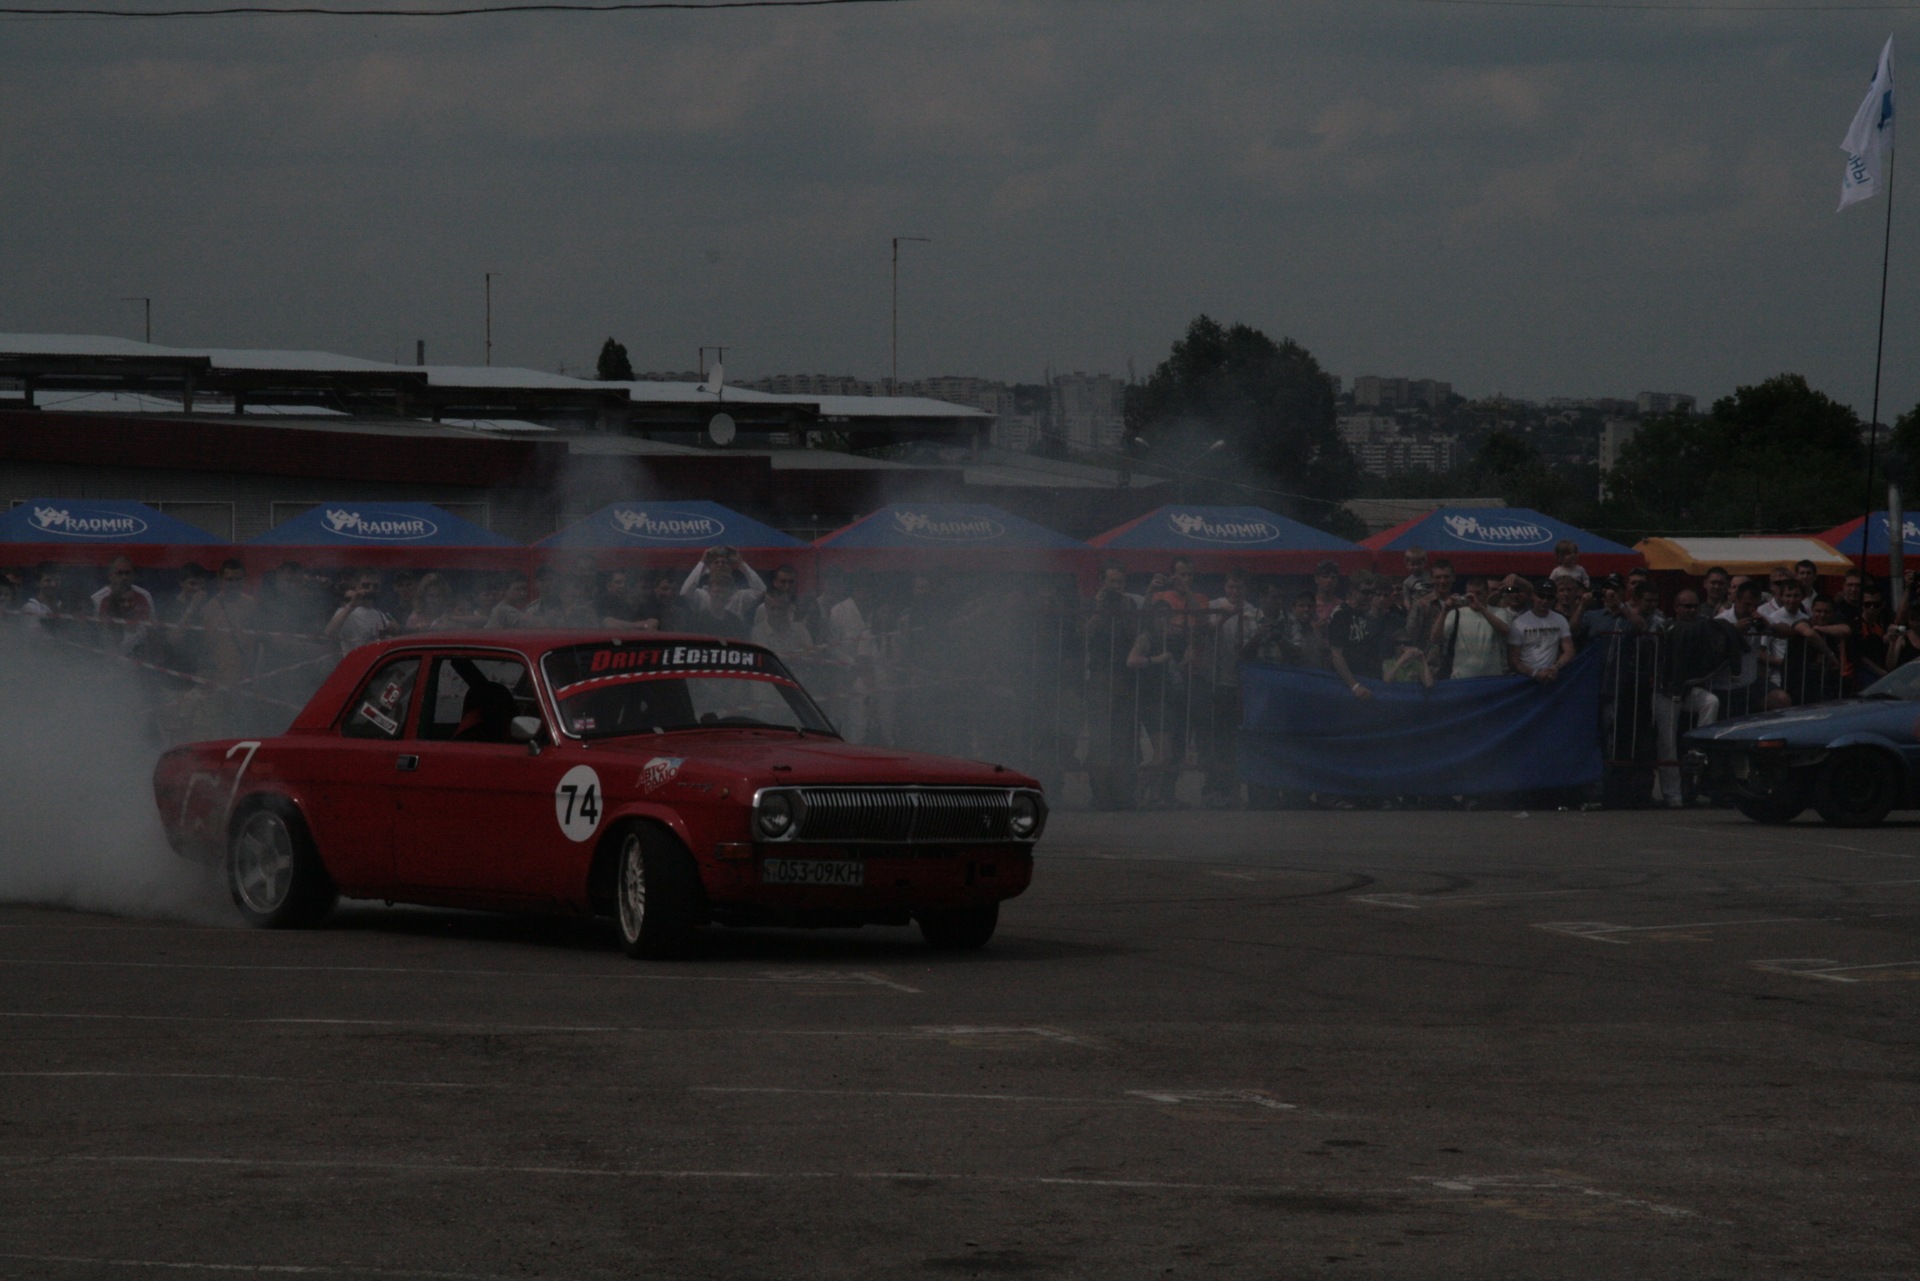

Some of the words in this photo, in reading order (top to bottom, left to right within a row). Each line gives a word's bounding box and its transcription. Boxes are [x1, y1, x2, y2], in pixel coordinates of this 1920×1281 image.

[65, 517, 134, 531] RADMIR
[357, 519, 425, 532] RADMIR
[646, 519, 712, 533] RADMIR
[1203, 522, 1268, 535] RADMIR
[1477, 525, 1542, 538] RADMIR
[561, 784, 598, 825] 74
